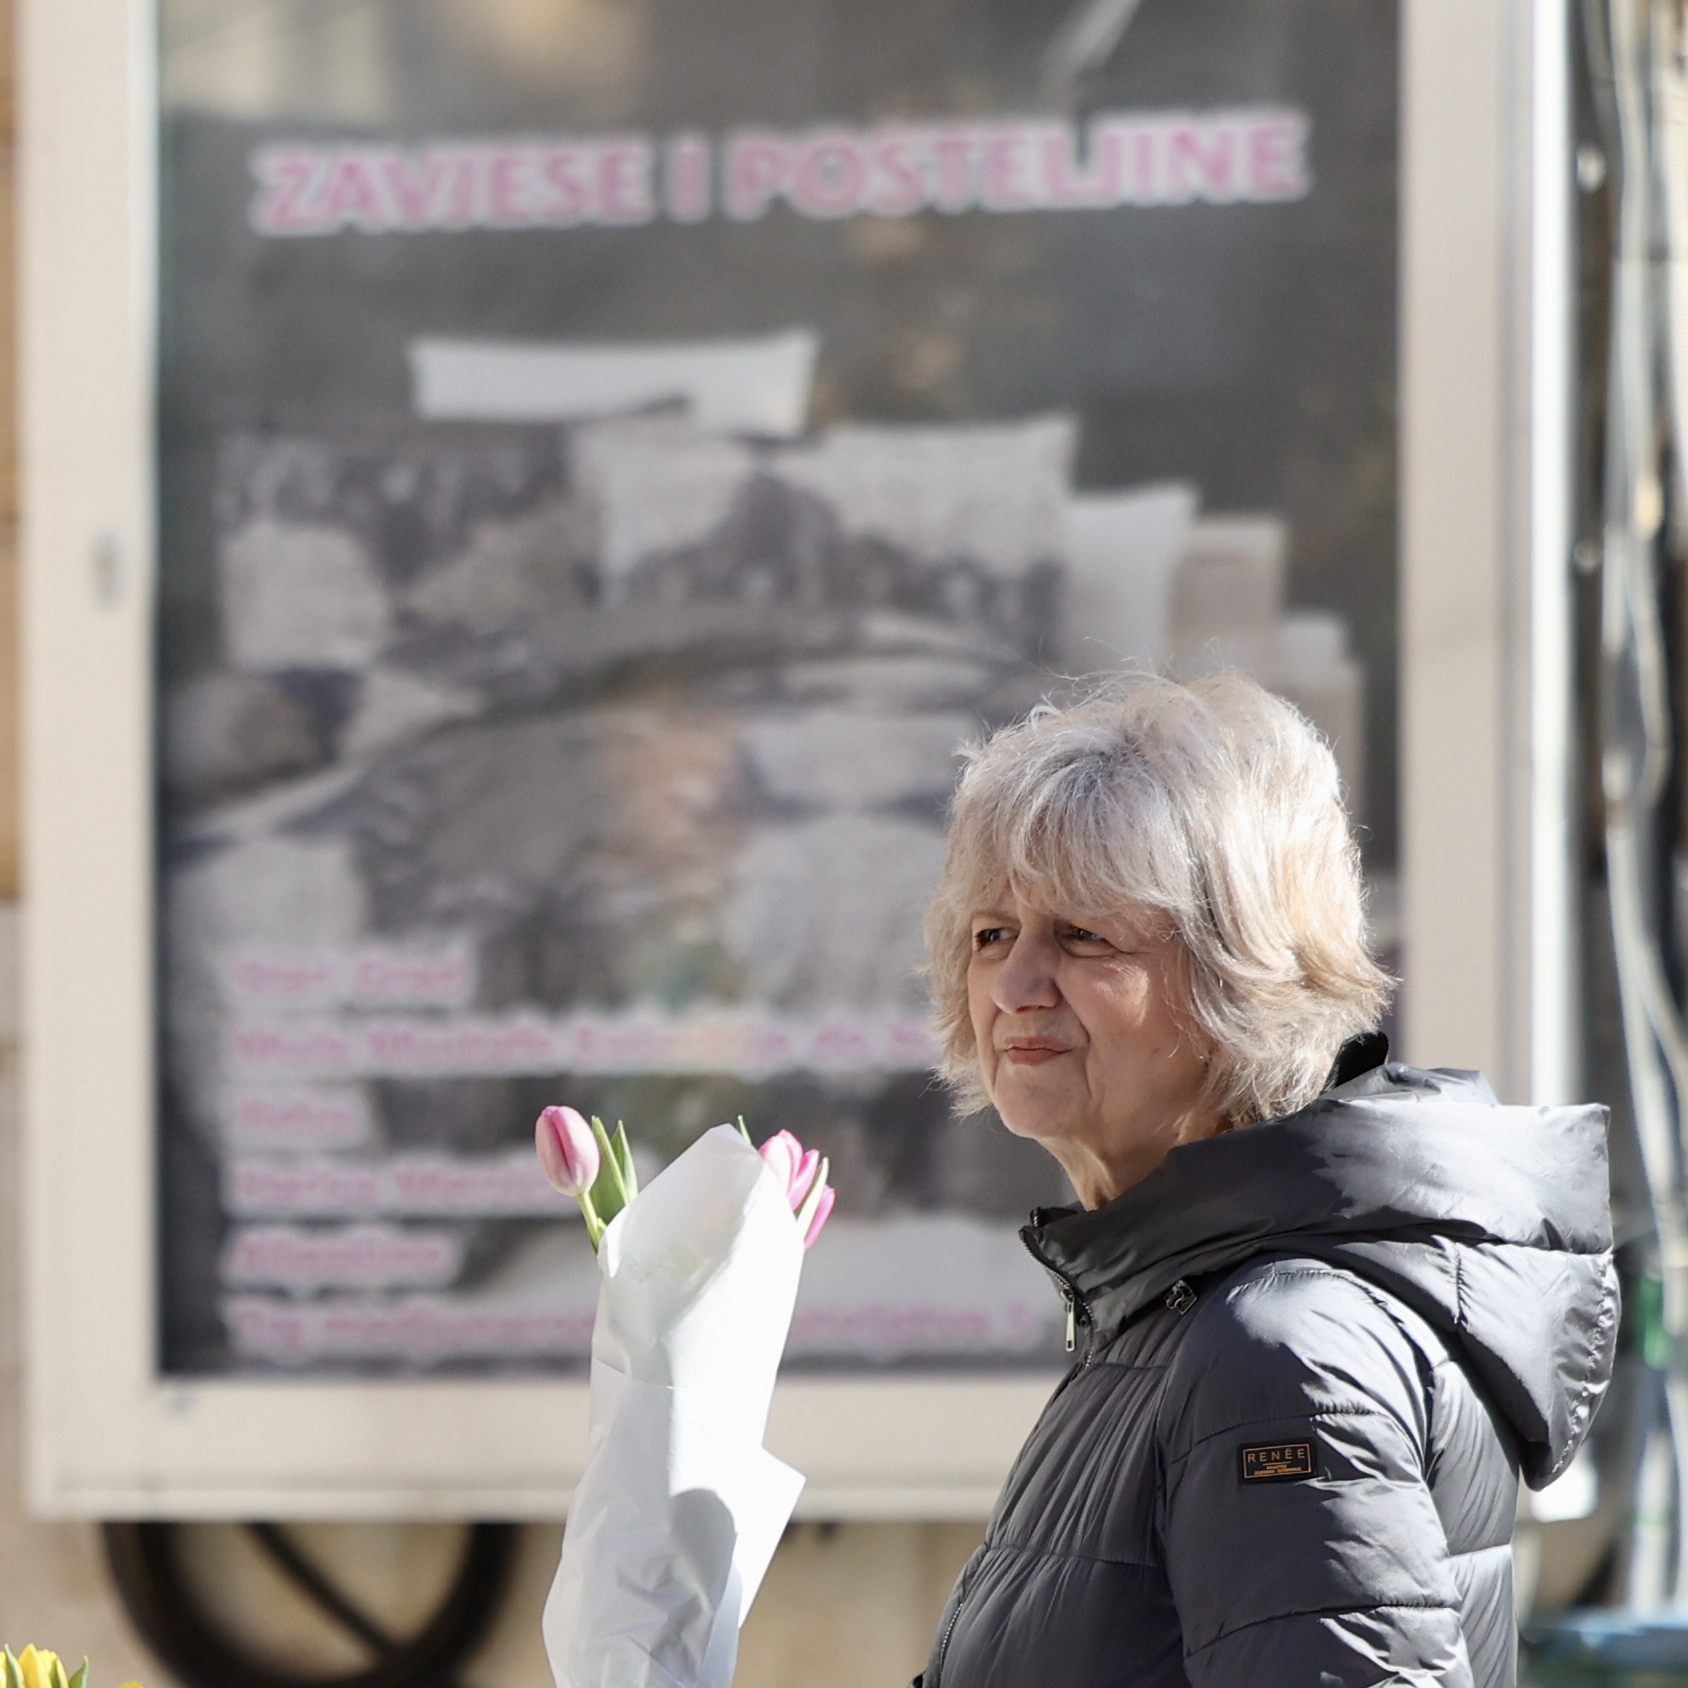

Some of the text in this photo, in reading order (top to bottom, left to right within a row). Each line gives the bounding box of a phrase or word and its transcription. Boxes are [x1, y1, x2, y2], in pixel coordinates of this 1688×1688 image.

[669, 136, 710, 218] I
[726, 114, 1305, 220] POSTELJINE
[1247, 1447, 1305, 1463] RENÉE
